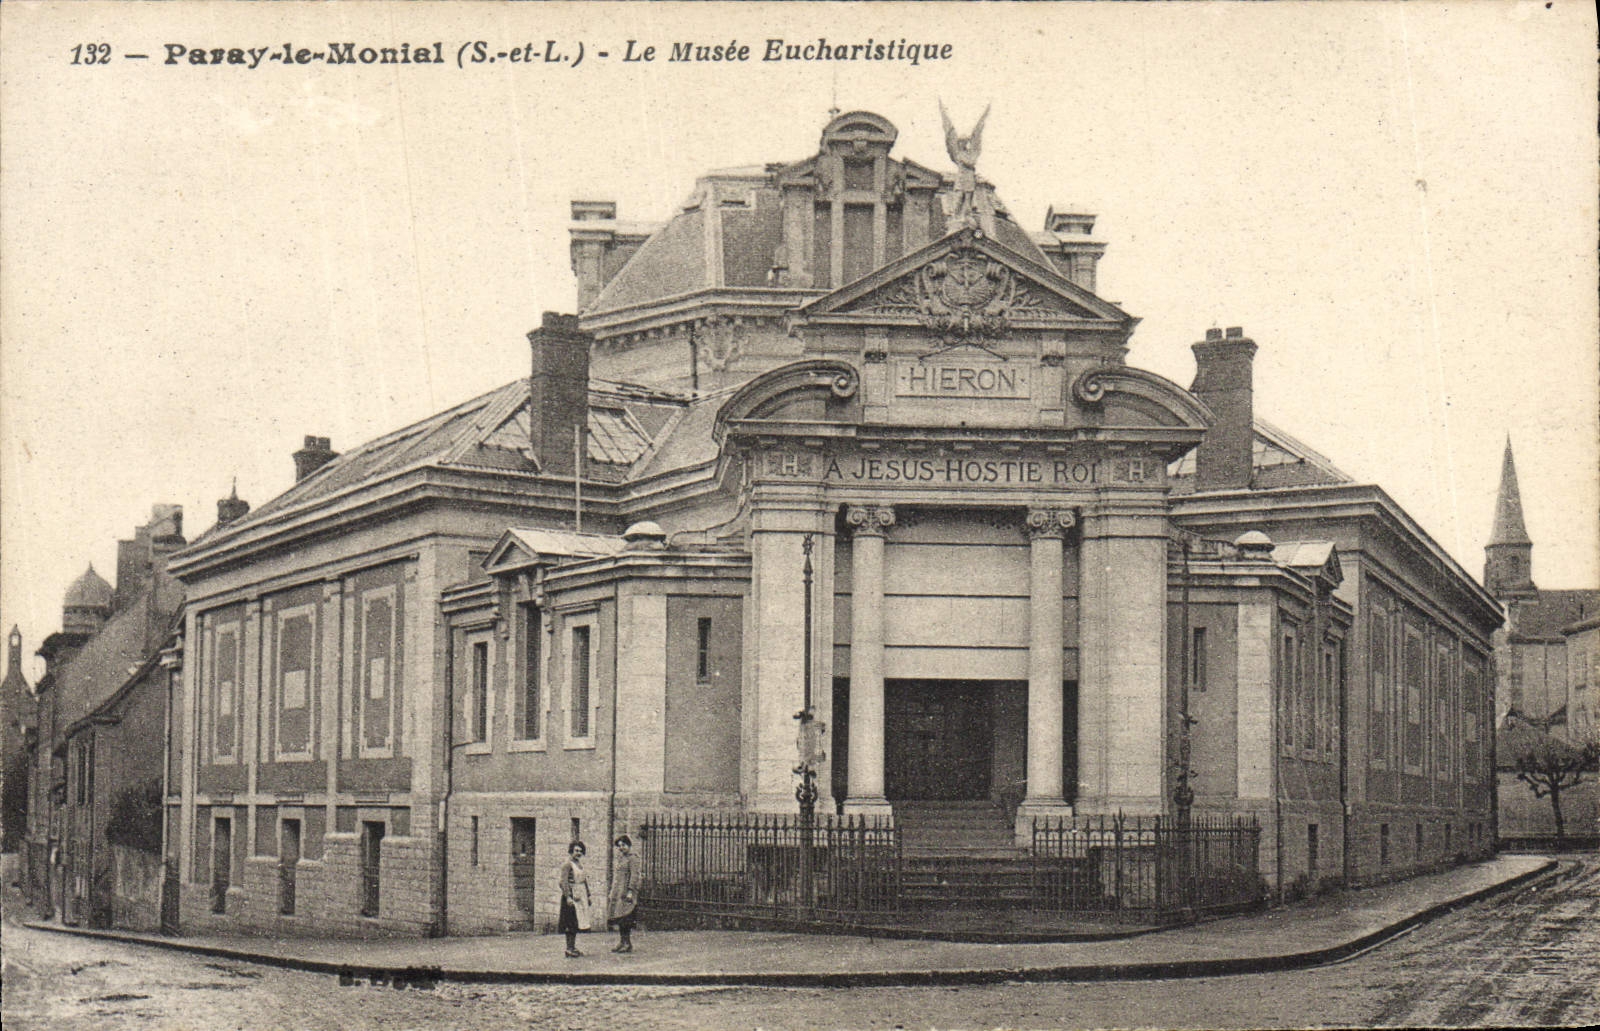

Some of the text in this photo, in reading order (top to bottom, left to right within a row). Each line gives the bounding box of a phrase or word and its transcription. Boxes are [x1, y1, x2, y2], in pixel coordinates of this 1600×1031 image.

[825, 460, 1099, 482] A JESUS-HOSTIE ROI
